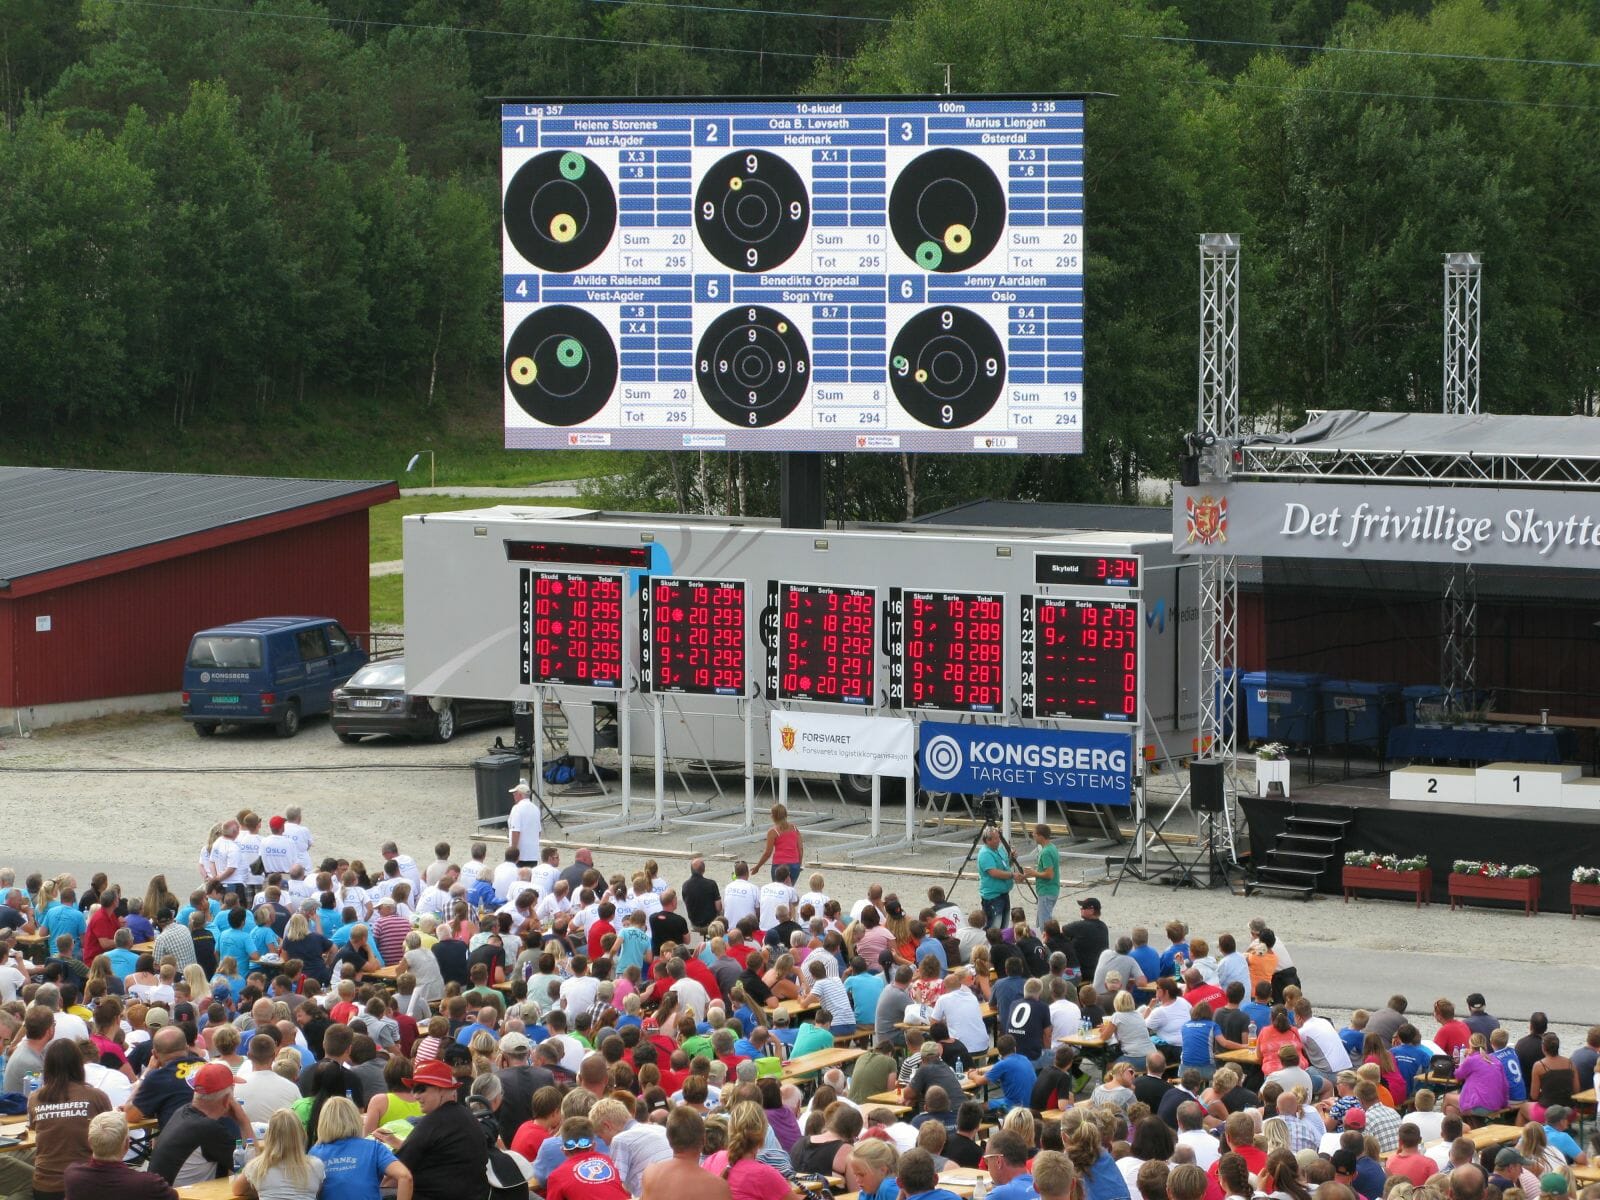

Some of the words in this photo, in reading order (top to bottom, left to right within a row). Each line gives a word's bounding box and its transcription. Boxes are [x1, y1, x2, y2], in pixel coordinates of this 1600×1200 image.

[525, 106, 542, 116] Lag
[547, 106, 563, 115] 357
[797, 104, 842, 112] 10-skudd
[938, 103, 965, 112] 100m
[1032, 103, 1055, 112] 3:35
[575, 120, 609, 129] Helene
[612, 120, 658, 129] Storenes
[769, 119, 790, 128] Oda
[794, 119, 804, 128] B.
[966, 118, 1001, 127] Marius
[516, 125, 524, 143] 1
[706, 124, 717, 141] 2
[902, 123, 912, 141] 3
[982, 133, 1026, 143] Østerdal
[586, 136, 643, 147] Aust-Agder
[785, 135, 831, 143] Hedmark
[628, 152, 645, 161] X.3
[821, 151, 837, 160] X.1
[1018, 150, 1035, 160] X.3
[746, 155, 758, 173] 9
[703, 202, 714, 220] 9
[790, 202, 801, 220] 9
[624, 235, 649, 244] Sum
[673, 235, 685, 244] 20
[817, 235, 842, 244] Sum
[867, 235, 879, 244] 10
[1013, 235, 1039, 244] Sum
[1063, 235, 1077, 244] 20
[625, 257, 643, 266] Tot
[666, 257, 685, 266] 295
[747, 249, 758, 266] 9
[818, 257, 835, 266] Tot
[860, 257, 879, 266] 295
[1013, 257, 1032, 266] Tot
[1056, 257, 1077, 267] 295
[573, 276, 606, 285] Alvilde
[761, 276, 811, 285] Benedikte
[815, 276, 859, 288] Oppedal
[965, 277, 994, 288] Jenny
[999, 277, 1046, 285] Aardalen
[516, 280, 528, 297] 4
[708, 280, 718, 298] 5
[901, 281, 912, 298] 6
[587, 291, 643, 302] Vest-Agder
[783, 292, 810, 303] Sogn
[813, 292, 833, 301] Ytre
[992, 292, 1016, 301] Oslo
[749, 309, 756, 320] 8
[822, 309, 837, 317] 8.7
[1018, 309, 1034, 318] 9.4
[942, 311, 953, 329] 9
[629, 323, 646, 332] X.4
[1018, 325, 1035, 334] X.2
[749, 330, 756, 342] 9
[701, 361, 708, 372] 8
[720, 360, 728, 372] 9
[778, 361, 785, 373] 9
[797, 361, 805, 373] 8
[898, 358, 909, 376] 9
[986, 359, 997, 376] 9
[625, 389, 650, 399] Sum
[674, 389, 686, 399] 20
[818, 390, 843, 400] Sum
[874, 391, 879, 400] 8
[1013, 392, 1039, 401] Sum
[1064, 392, 1076, 401] 19
[626, 412, 643, 421] Tot
[667, 412, 686, 422] 295
[818, 413, 836, 422] Tot
[860, 413, 879, 423] 294
[942, 405, 953, 422] 9
[1014, 415, 1032, 424] Tot
[1056, 415, 1076, 424] 294
[1280, 503, 1342, 537] Det
[1342, 503, 1492, 552] frivillige
[1098, 560, 1135, 577] 3:34
[524, 582, 527, 593] 1
[592, 582, 619, 598] 295
[642, 589, 648, 601] 6
[713, 588, 741, 605] 294
[769, 594, 777, 606] 11
[523, 602, 528, 613] 2
[592, 602, 619, 619] 295
[843, 596, 872, 613] 292
[891, 601, 901, 614] 16
[970, 602, 999, 619] 290
[643, 609, 648, 621] 7
[713, 609, 741, 625] 293
[769, 614, 778, 627] 12
[1023, 609, 1033, 621] 21
[1104, 609, 1134, 627] 273
[523, 622, 528, 633] 3
[592, 622, 619, 639] 295
[843, 616, 872, 633] 292
[891, 622, 901, 635] 17
[643, 629, 648, 641] 8
[713, 629, 741, 646] 292
[970, 623, 999, 640] 289
[1022, 630, 1033, 642] 22
[769, 635, 778, 647] 13
[843, 637, 872, 654] 292
[1104, 631, 1134, 648] 237
[523, 641, 528, 653] 4
[592, 642, 619, 659] 295
[891, 643, 901, 655] 18
[970, 644, 999, 662] 289
[643, 650, 648, 661] 9
[713, 650, 741, 666] 292
[1022, 652, 1033, 664] 23
[1125, 653, 1134, 670] 0
[523, 661, 528, 673] 5
[768, 656, 777, 668] 14
[842, 658, 870, 675] 291
[592, 662, 619, 678] 294
[641, 670, 650, 682] 10
[891, 664, 901, 676] 19
[970, 665, 999, 682] 287
[713, 670, 741, 687] 292
[768, 676, 777, 689] 15
[1022, 672, 1033, 685] 24
[842, 679, 870, 696] 291
[891, 685, 902, 697] 20
[970, 686, 999, 703] 287
[1023, 694, 1033, 706] 25
[803, 733, 851, 744] FORSVARET
[803, 747, 837, 756] Forsvarets
[970, 742, 1125, 772] KONGSBERG
[970, 767, 1036, 784] TARGET
[1044, 772, 1125, 790] SYSTEMS
[1513, 776, 1521, 793] 1
[1427, 779, 1438, 794] 2
[1011, 1002, 1031, 1028] 0
[1508, 1060, 1521, 1082] 9
[34, 1102, 90, 1113] HAMMERFEST
